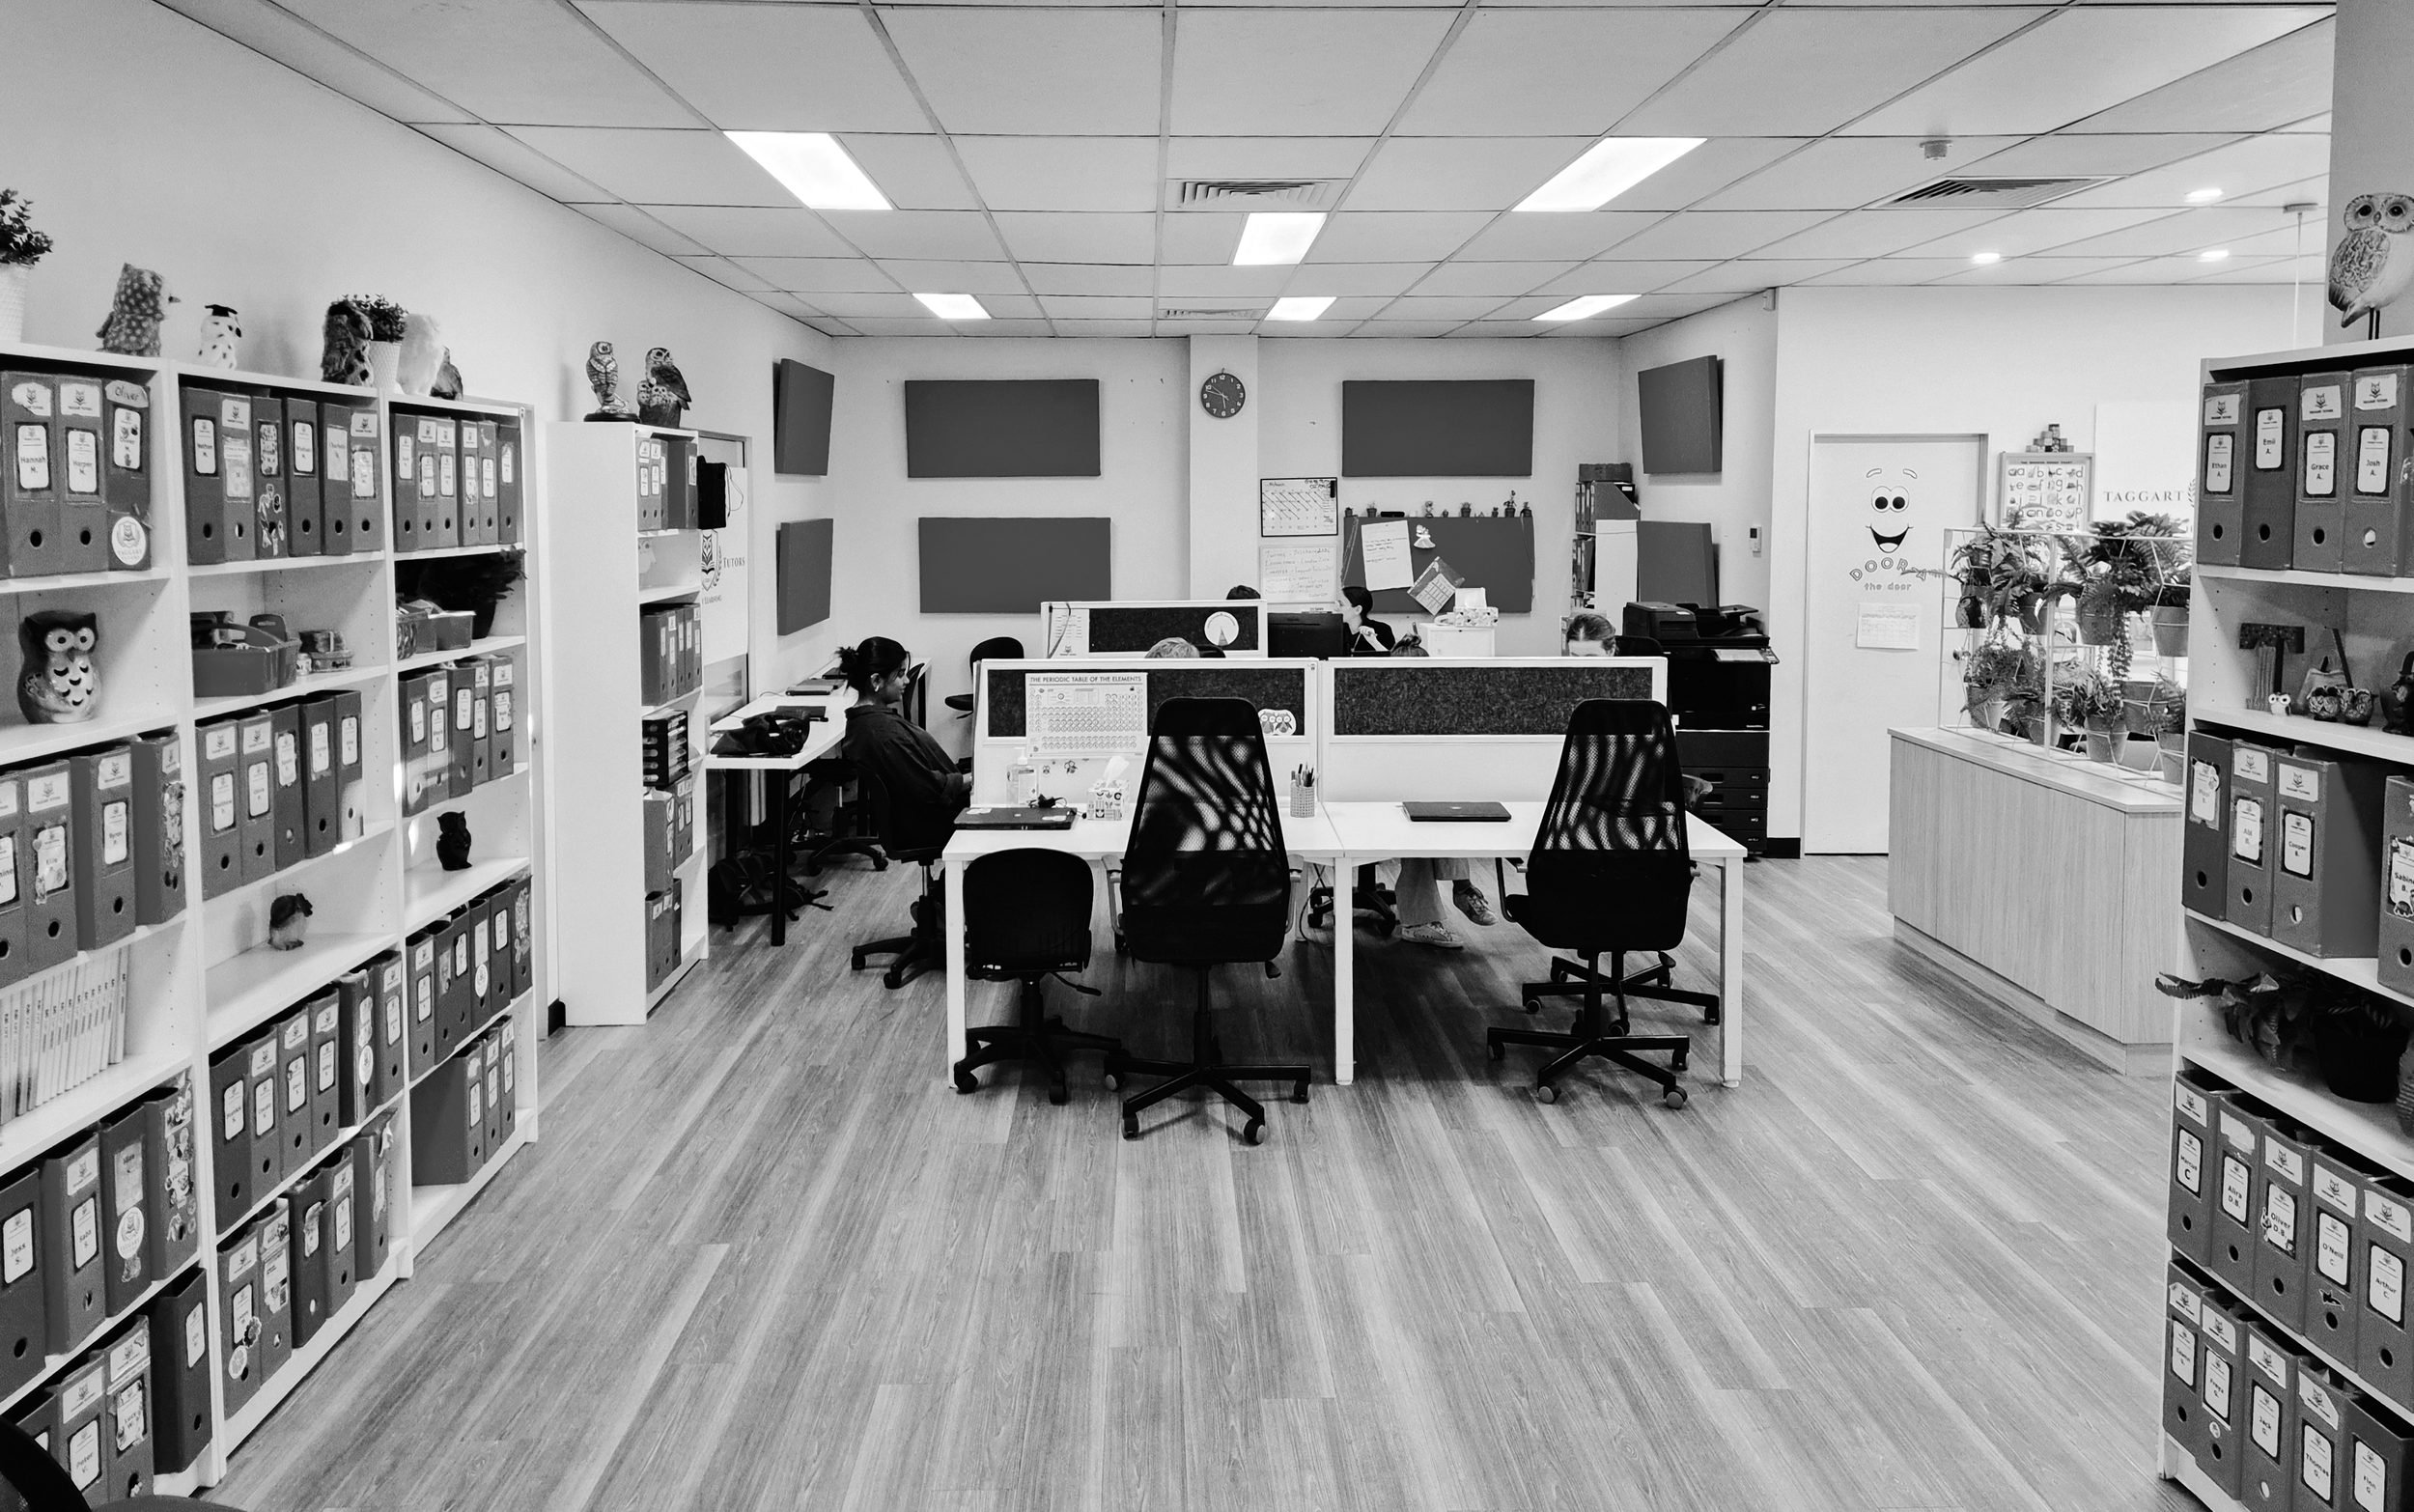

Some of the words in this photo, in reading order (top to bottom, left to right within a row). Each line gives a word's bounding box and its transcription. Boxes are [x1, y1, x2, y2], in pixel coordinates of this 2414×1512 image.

[115, 386, 139, 401] Oliver
[2103, 490, 2184, 502] TAGGART
[723, 557, 745, 568] TUTORS
[1864, 582, 1882, 591] the
[1887, 582, 1912, 591] door
[2288, 841, 2307, 851] Cooper
[2401, 884, 2408, 893] B.
[2180, 1155, 2198, 1171] Marcus
[2228, 1185, 2242, 1199] Alira
[2228, 1195, 2241, 1208] D.B.
[2270, 1213, 2291, 1229] Oliver
[2273, 1224, 2288, 1240] D.B.
[11, 1243, 26, 1256] Jess
[2375, 1277, 2397, 1294] Arthur
[2383, 1291, 2390, 1300] C.
[2209, 1378, 2225, 1394] Freya
[124, 1412, 137, 1423] Lucy
[2259, 1416, 2272, 1430] Jack
[2262, 1427, 2268, 1437] G.
[76, 1452, 94, 1468] Peter
[2306, 1453, 2329, 1477] Thomas
[2314, 1470, 2320, 1479] G.
[2364, 1475, 2376, 1490] Finn
[2366, 1487, 2372, 1496] G.
